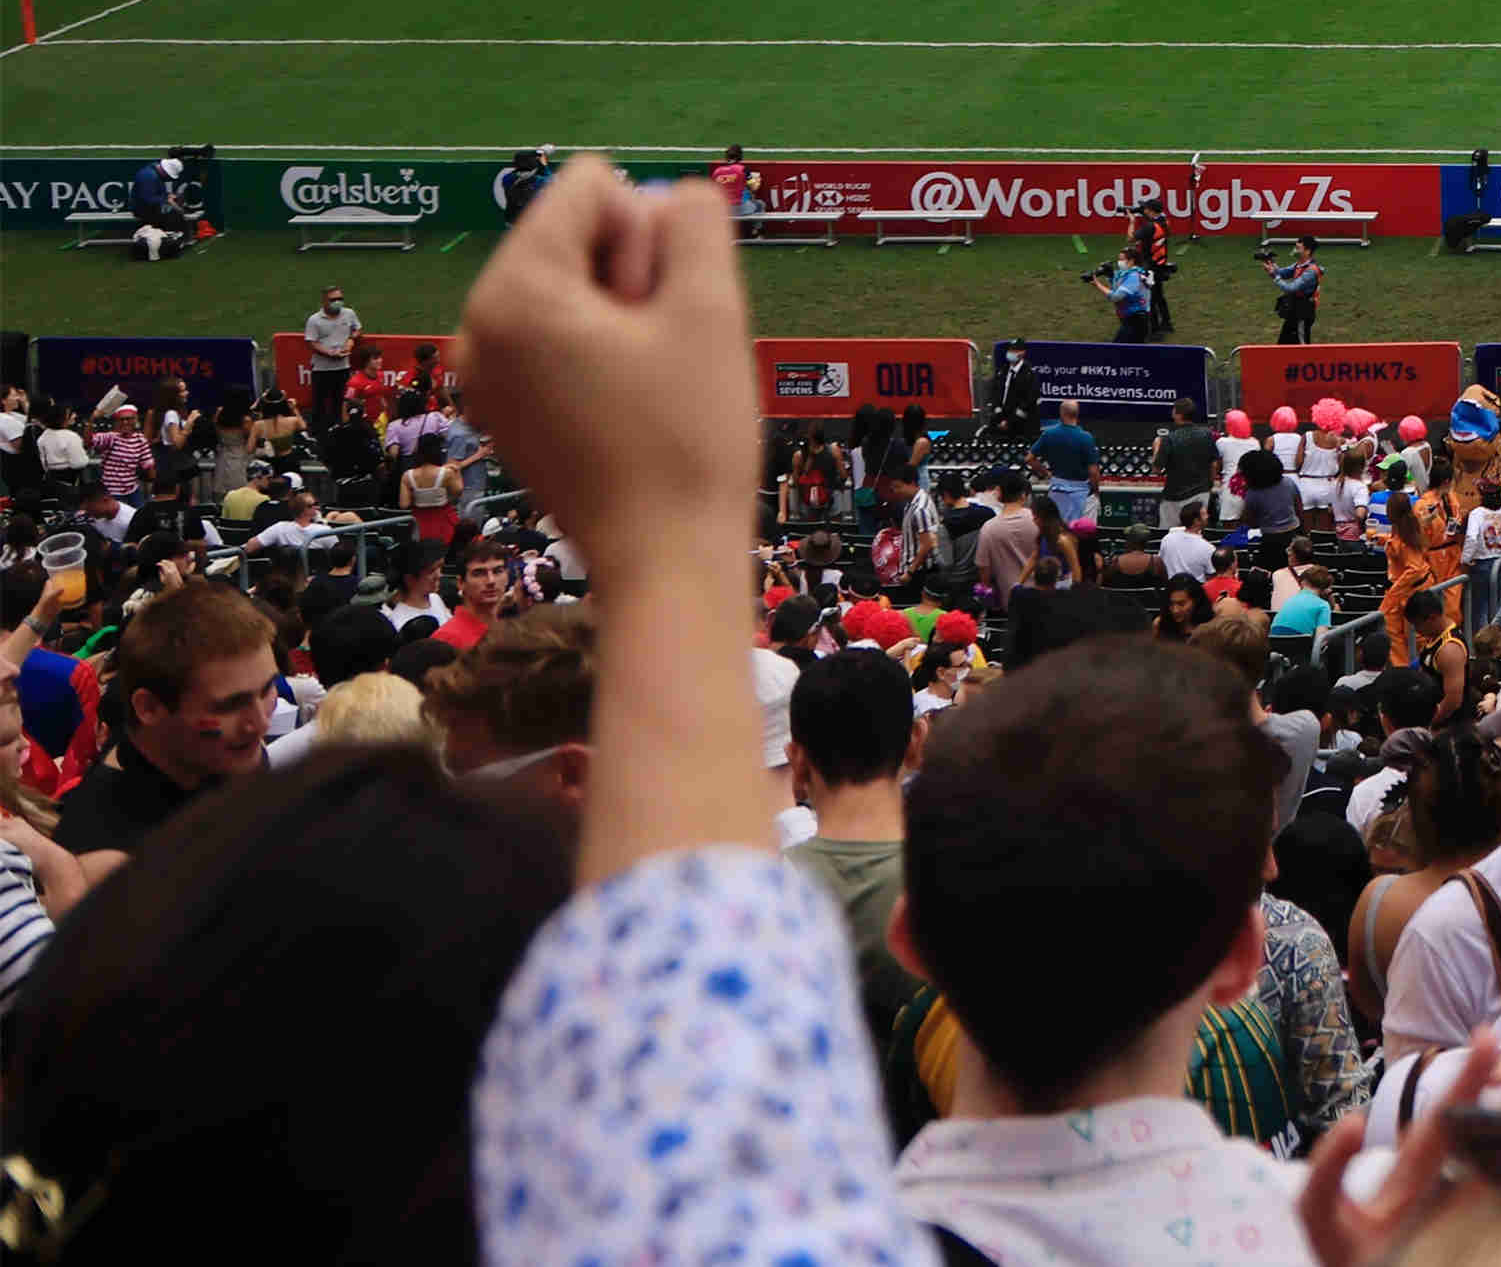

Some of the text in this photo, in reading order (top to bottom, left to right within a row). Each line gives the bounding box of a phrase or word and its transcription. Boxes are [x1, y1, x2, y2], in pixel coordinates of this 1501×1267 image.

[280, 165, 440, 214] Carlsberg
[910, 170, 1353, 231] @WorldRugby7s
[82, 356, 214, 377] #OURHK7s
[1054, 367, 1078, 378] your
[1080, 365, 1118, 376] #HK7s
[1285, 361, 1418, 385] #OURHK7s
[779, 386, 813, 394] SEVENS
[876, 363, 935, 397] OUR
